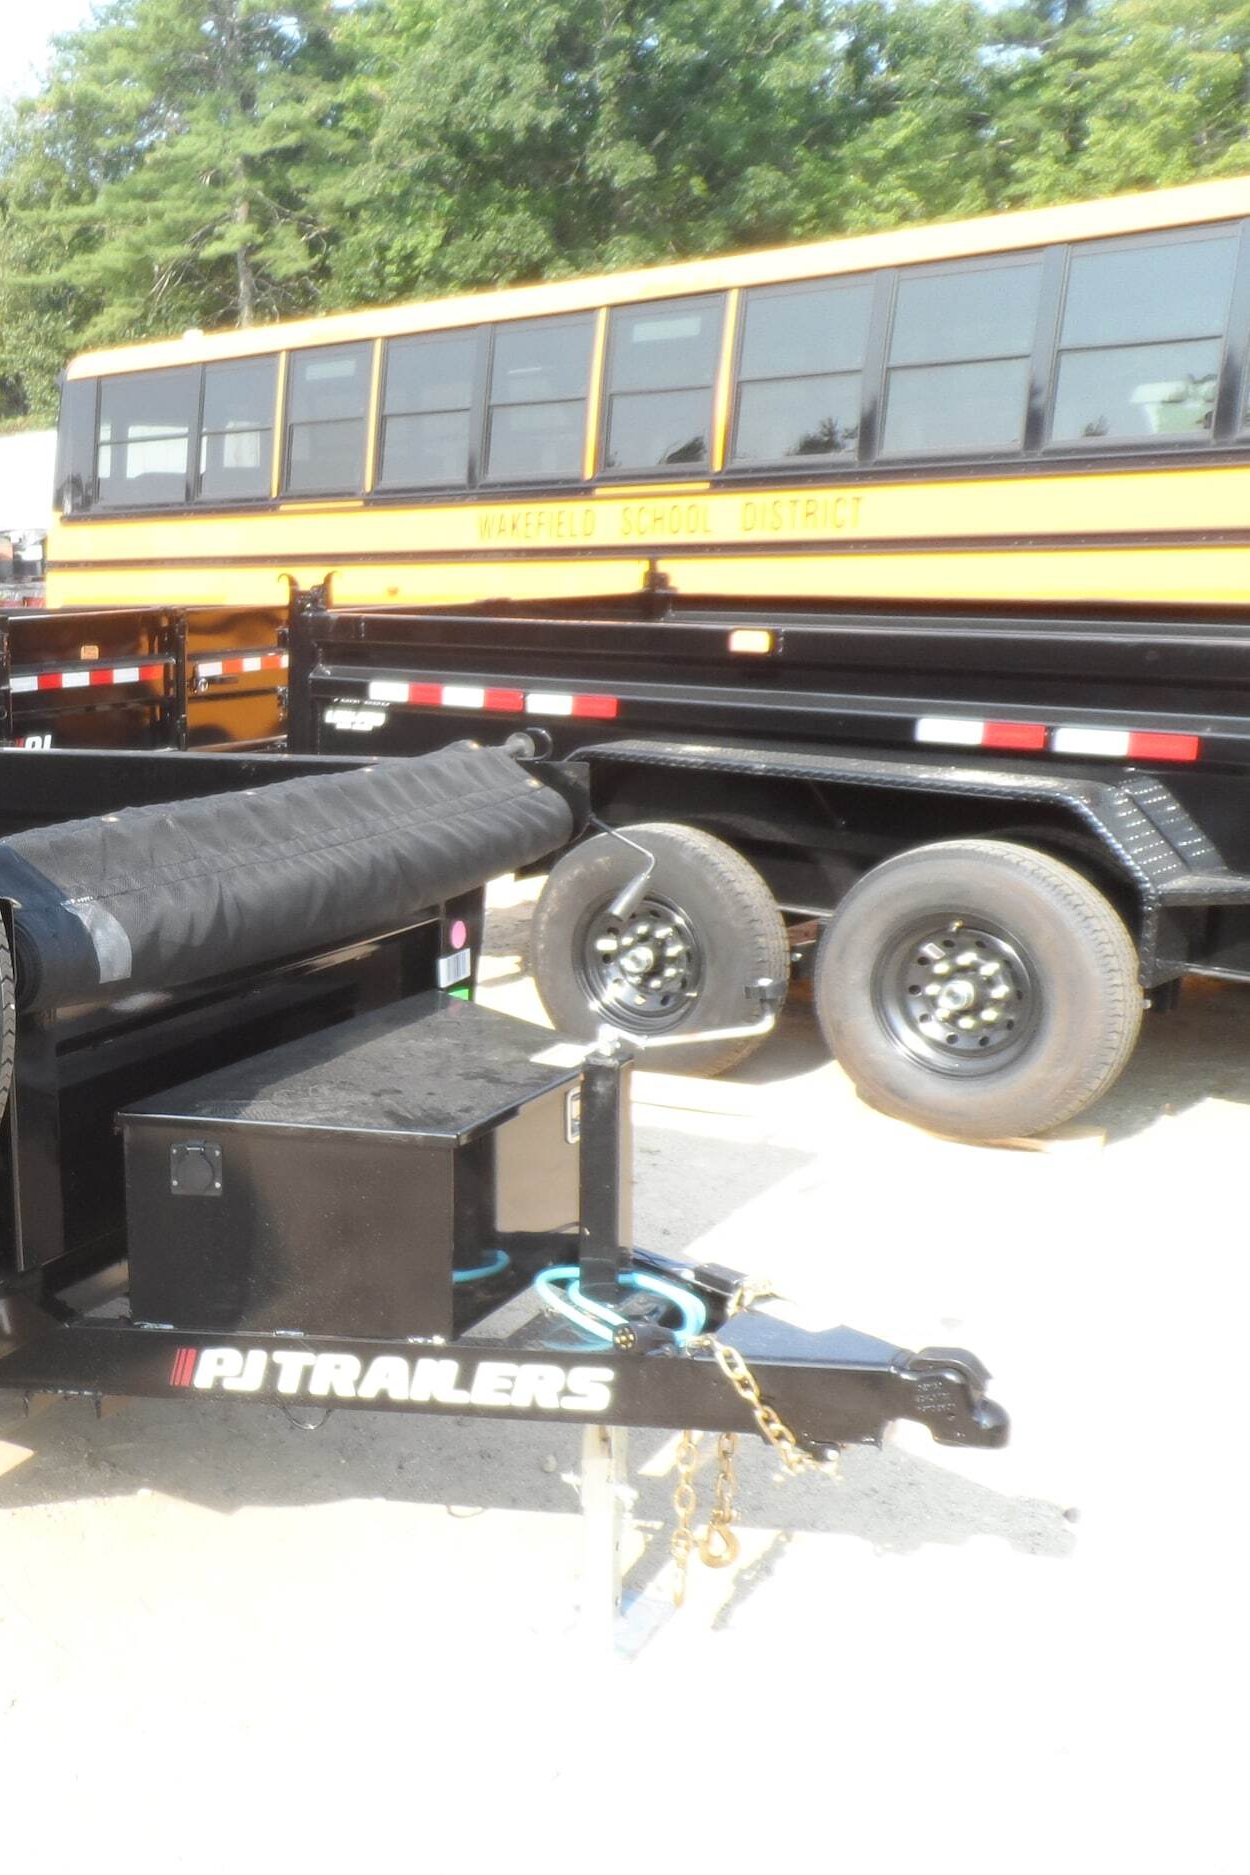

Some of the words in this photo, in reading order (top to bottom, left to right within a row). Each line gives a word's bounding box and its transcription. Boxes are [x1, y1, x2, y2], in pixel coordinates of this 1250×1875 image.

[478, 508, 597, 541] WAKEFIELD
[621, 503, 713, 536] SCHOOL
[741, 496, 864, 532] DISTRICT
[193, 1348, 266, 1391] PJ
[273, 1350, 615, 1411] TRAILERS
